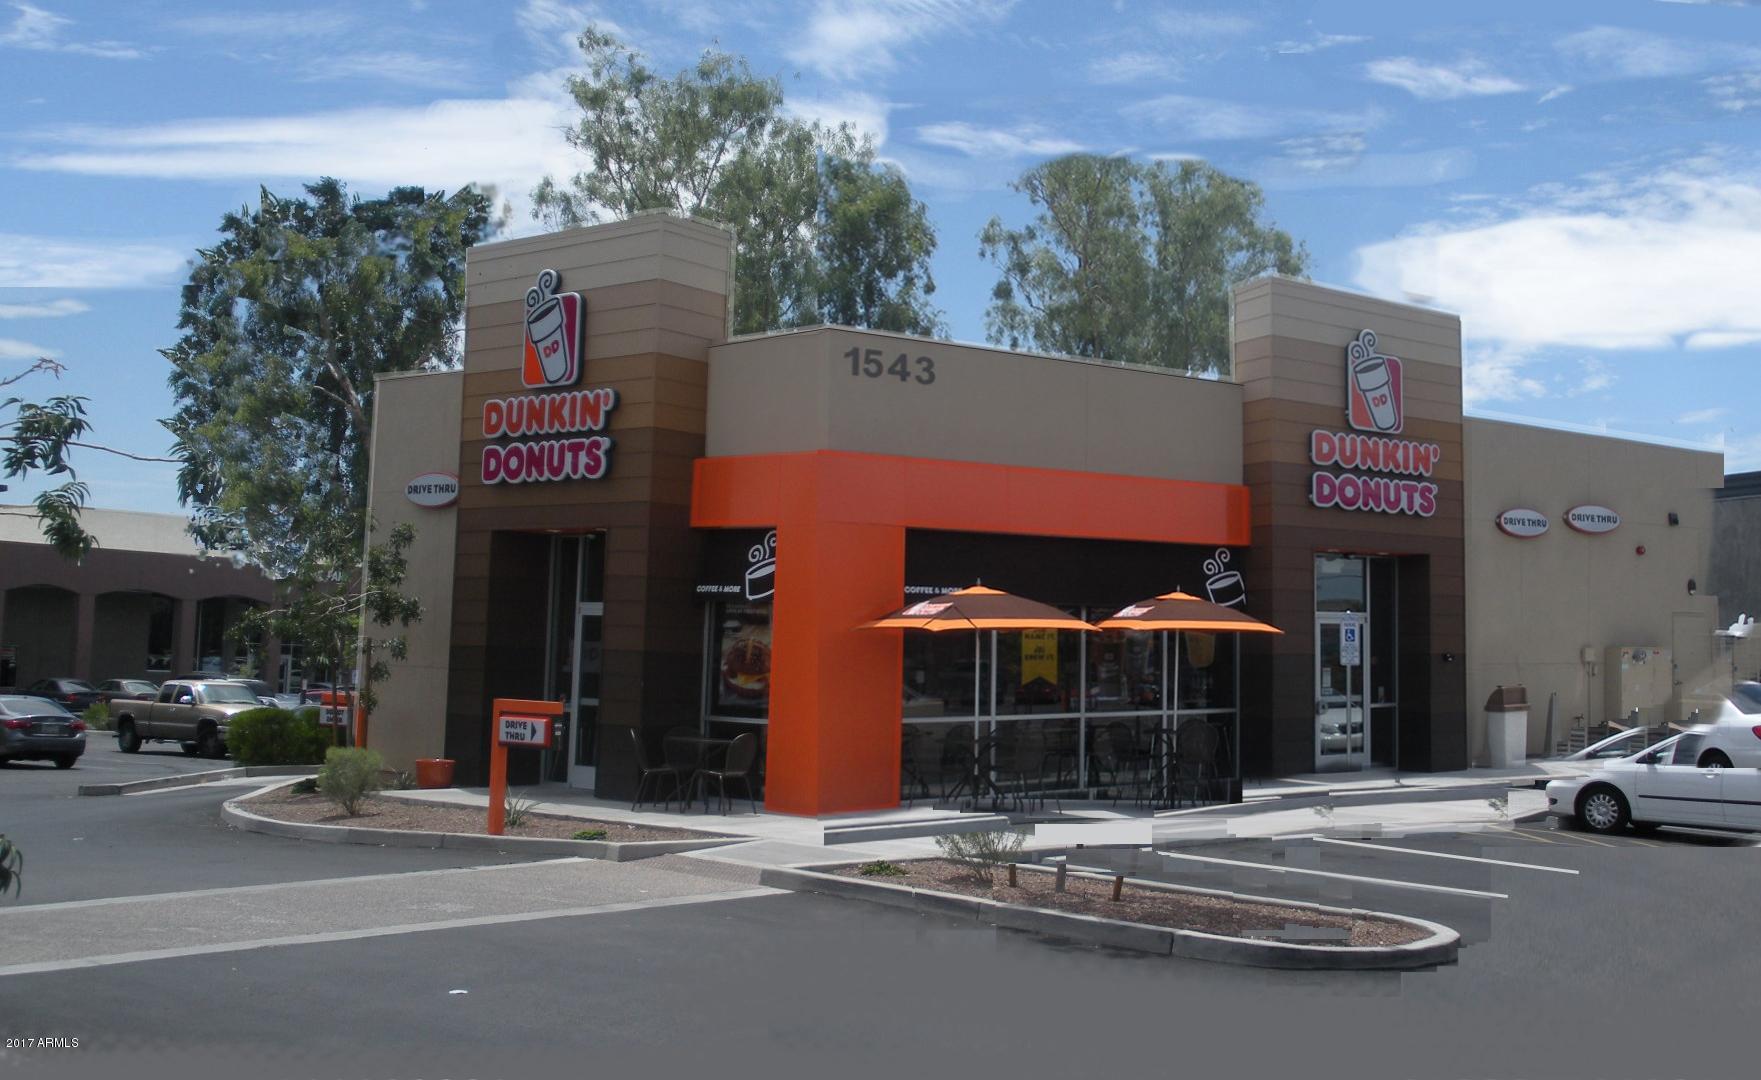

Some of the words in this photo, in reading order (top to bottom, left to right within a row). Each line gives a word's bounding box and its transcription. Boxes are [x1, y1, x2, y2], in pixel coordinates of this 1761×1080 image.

[543, 340, 560, 358] DD
[844, 346, 936, 385] 1543
[1372, 394, 1388, 407] DD
[482, 390, 614, 437] DUNKIN'
[1312, 430, 1440, 476] DUNKIN'
[481, 438, 609, 484] DONUTS
[407, 484, 432, 495] DRIVE
[433, 483, 457, 494] THRU
[1313, 472, 1437, 517] DONUTS
[1503, 517, 1526, 528] DRIVE
[1527, 518, 1548, 528] THRU
[1571, 513, 1596, 523] DRIVE
[1597, 514, 1618, 525] THRU
[723, 585, 741, 593] MORE
[904, 586, 933, 594] COFFEE
[505, 720, 528, 731] DRIVE
[505, 731, 526, 741] THRU
